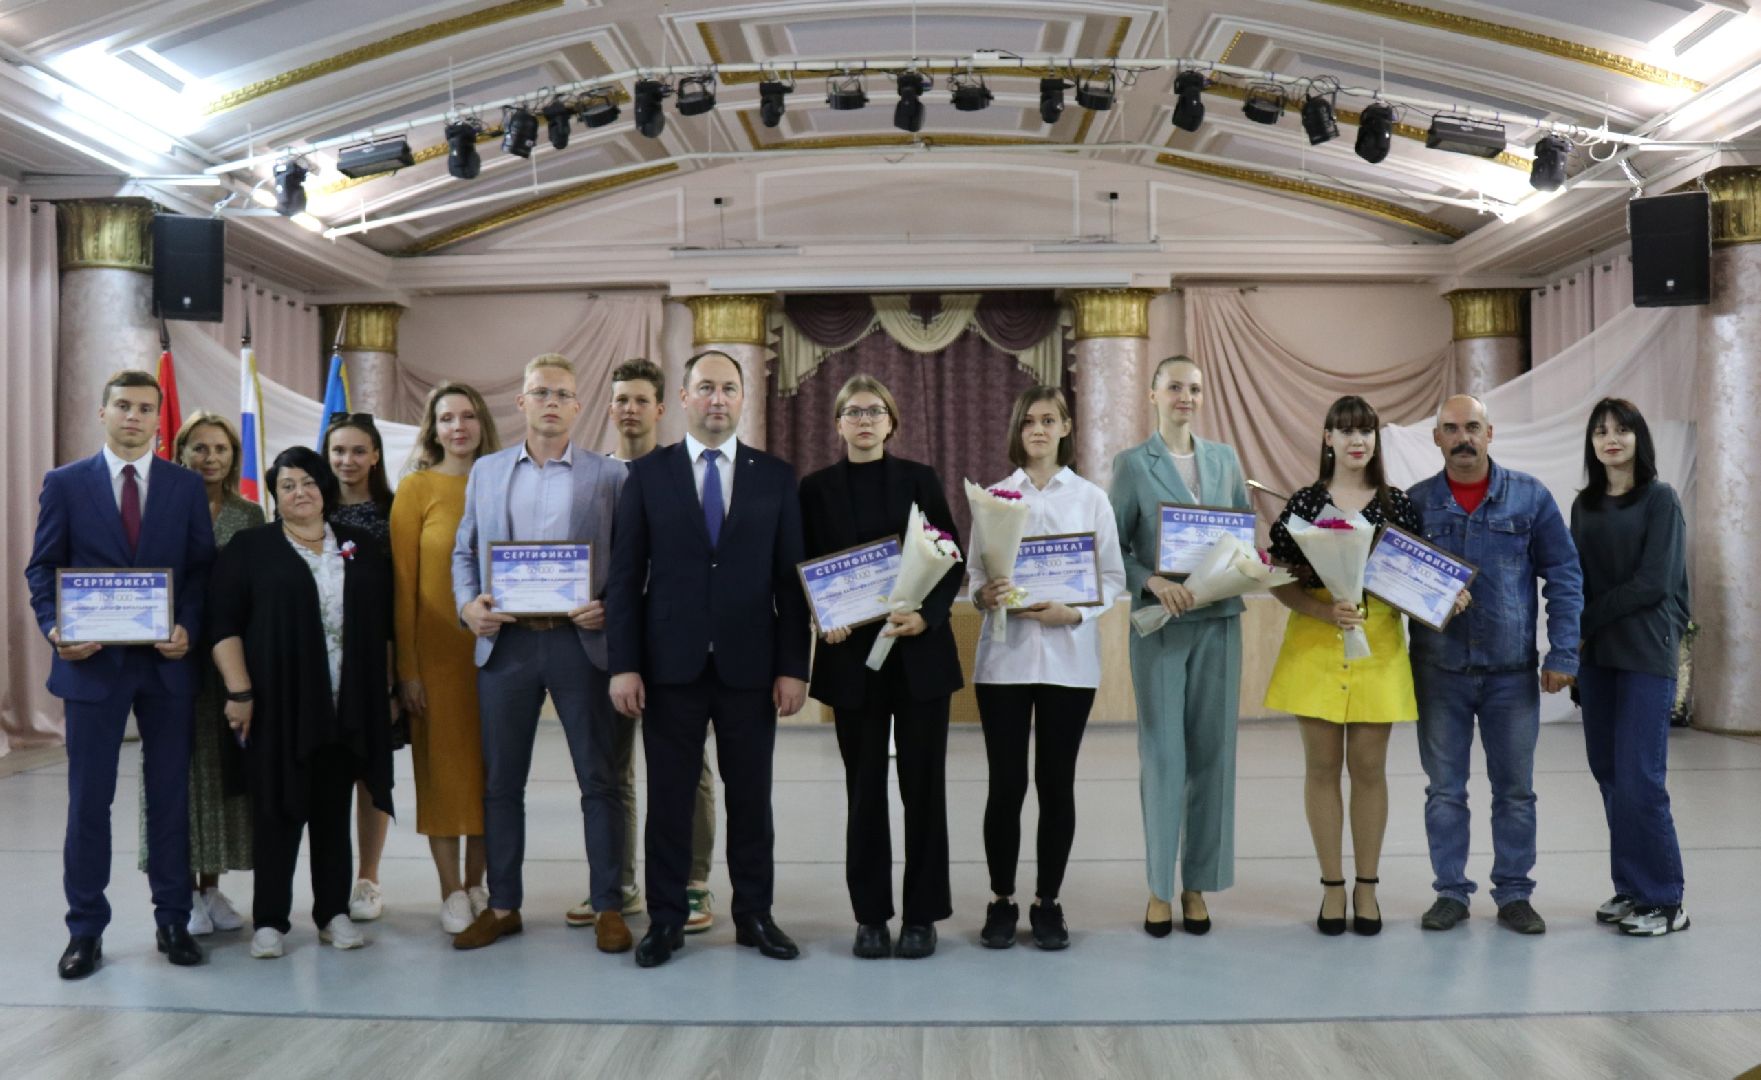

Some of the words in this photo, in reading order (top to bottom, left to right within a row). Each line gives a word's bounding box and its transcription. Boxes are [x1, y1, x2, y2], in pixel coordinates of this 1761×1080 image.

[1173, 512, 1245, 526] СЕРТИФИКАТ
[503, 550, 579, 560] СЕРТИФИКАТ
[1018, 542, 1084, 556] ЕРТИФИКАТ
[815, 547, 889, 576] СЕРТИФИКАТ
[1393, 537, 1461, 576] СЕРТИФИКАТ
[73, 578, 156, 587] СЕРТИФИКАТ
